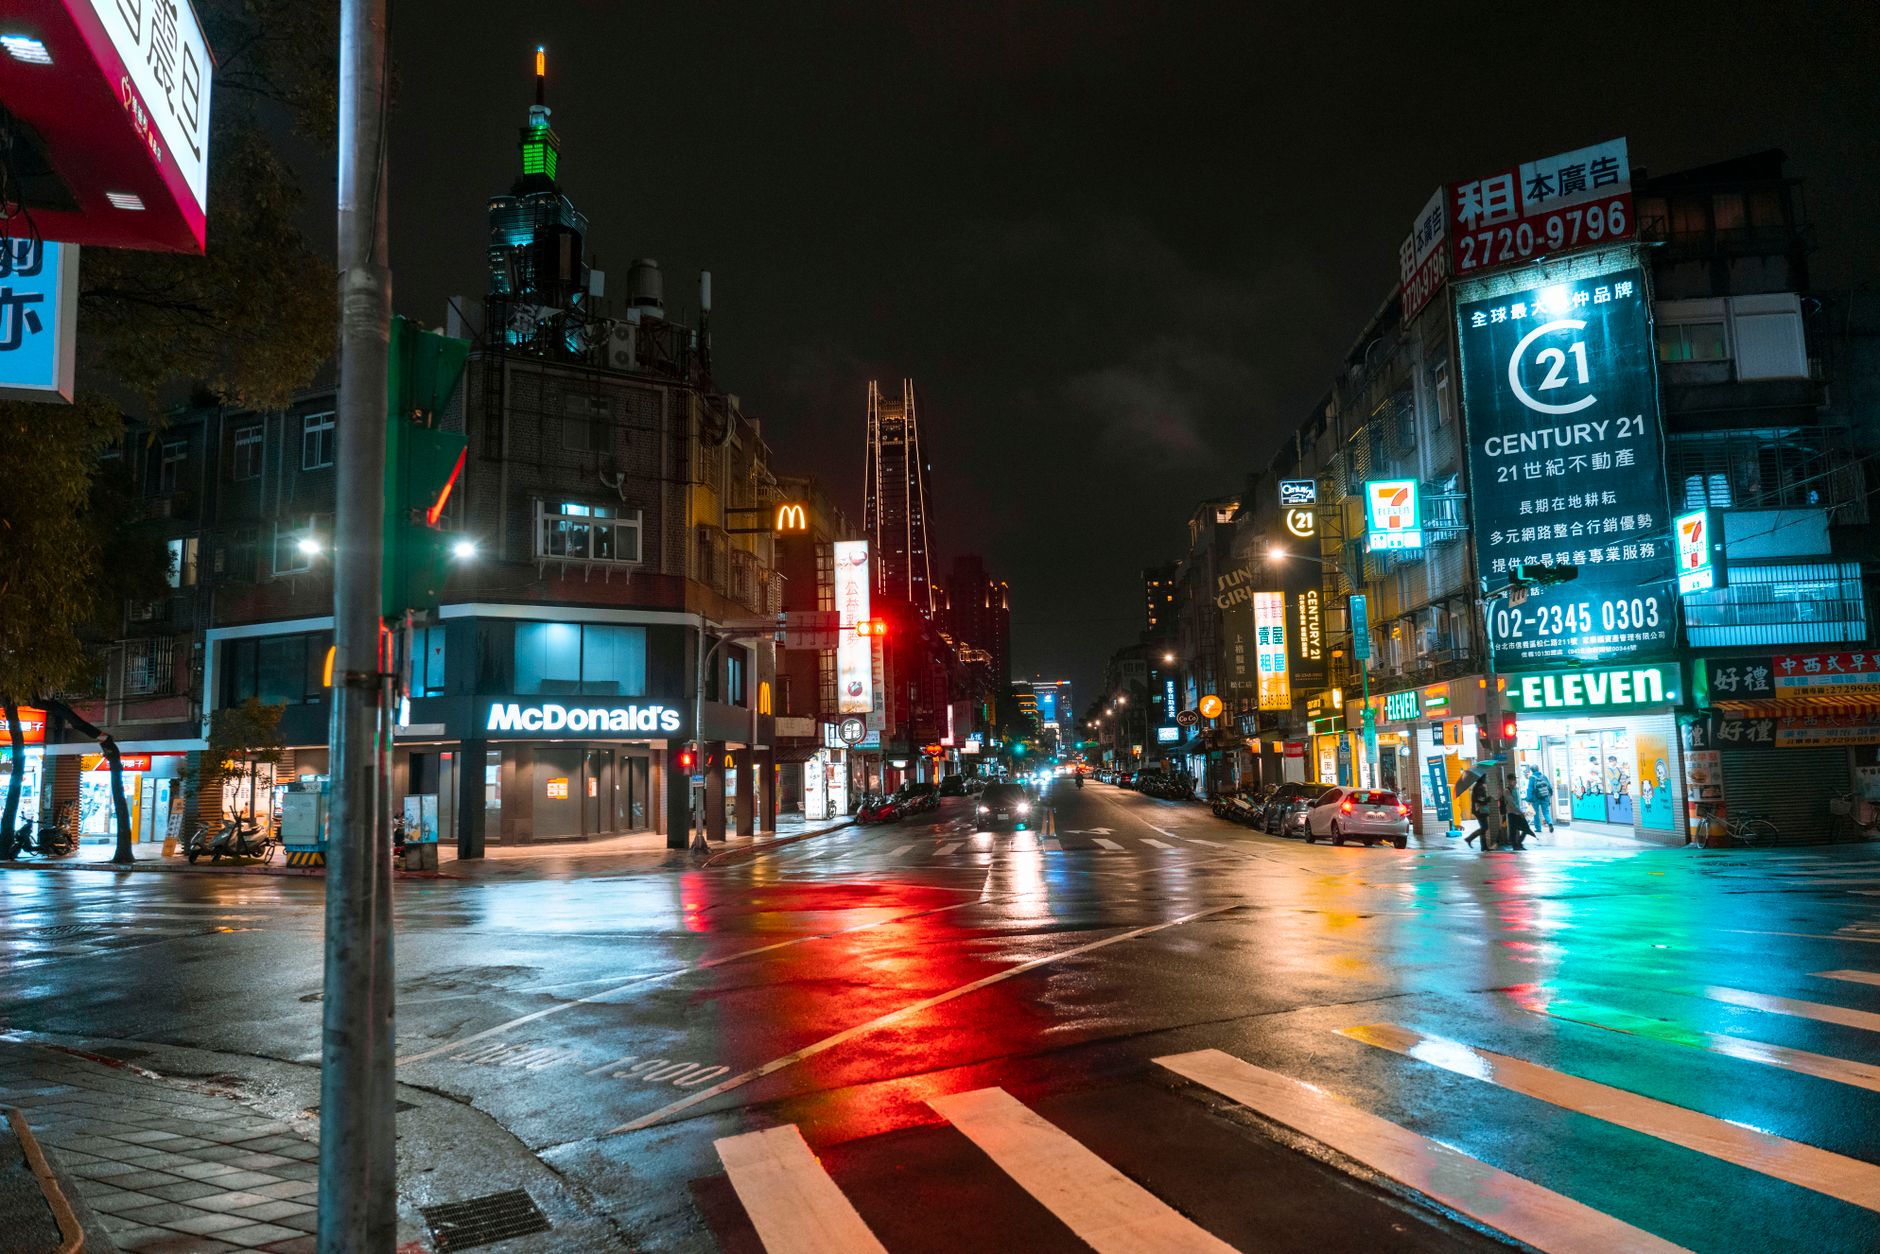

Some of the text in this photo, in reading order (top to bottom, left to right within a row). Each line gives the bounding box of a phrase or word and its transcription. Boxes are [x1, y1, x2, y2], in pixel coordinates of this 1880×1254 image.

[1457, 156, 1620, 231] 租 本廣告
[1416, 206, 1442, 255] 本廣告
[1460, 201, 1626, 269] 2720-9796
[1403, 246, 1445, 321] 2720-9796
[1471, 280, 1633, 328] 全球最大仲品牌
[1484, 414, 1645, 457] CENTURY 21
[1497, 448, 1635, 483] 21世紀不動產
[1519, 491, 1617, 515] 長期在地耕耘
[1490, 513, 1653, 546] 多元網路整合行銷優勢
[1307, 590, 1321, 660] CENTURY 21
[1497, 597, 1659, 638] 02-2345 0303
[1714, 666, 1770, 692] 好禮
[487, 703, 681, 731] McDonald's
[1717, 718, 1773, 743] 好禮
